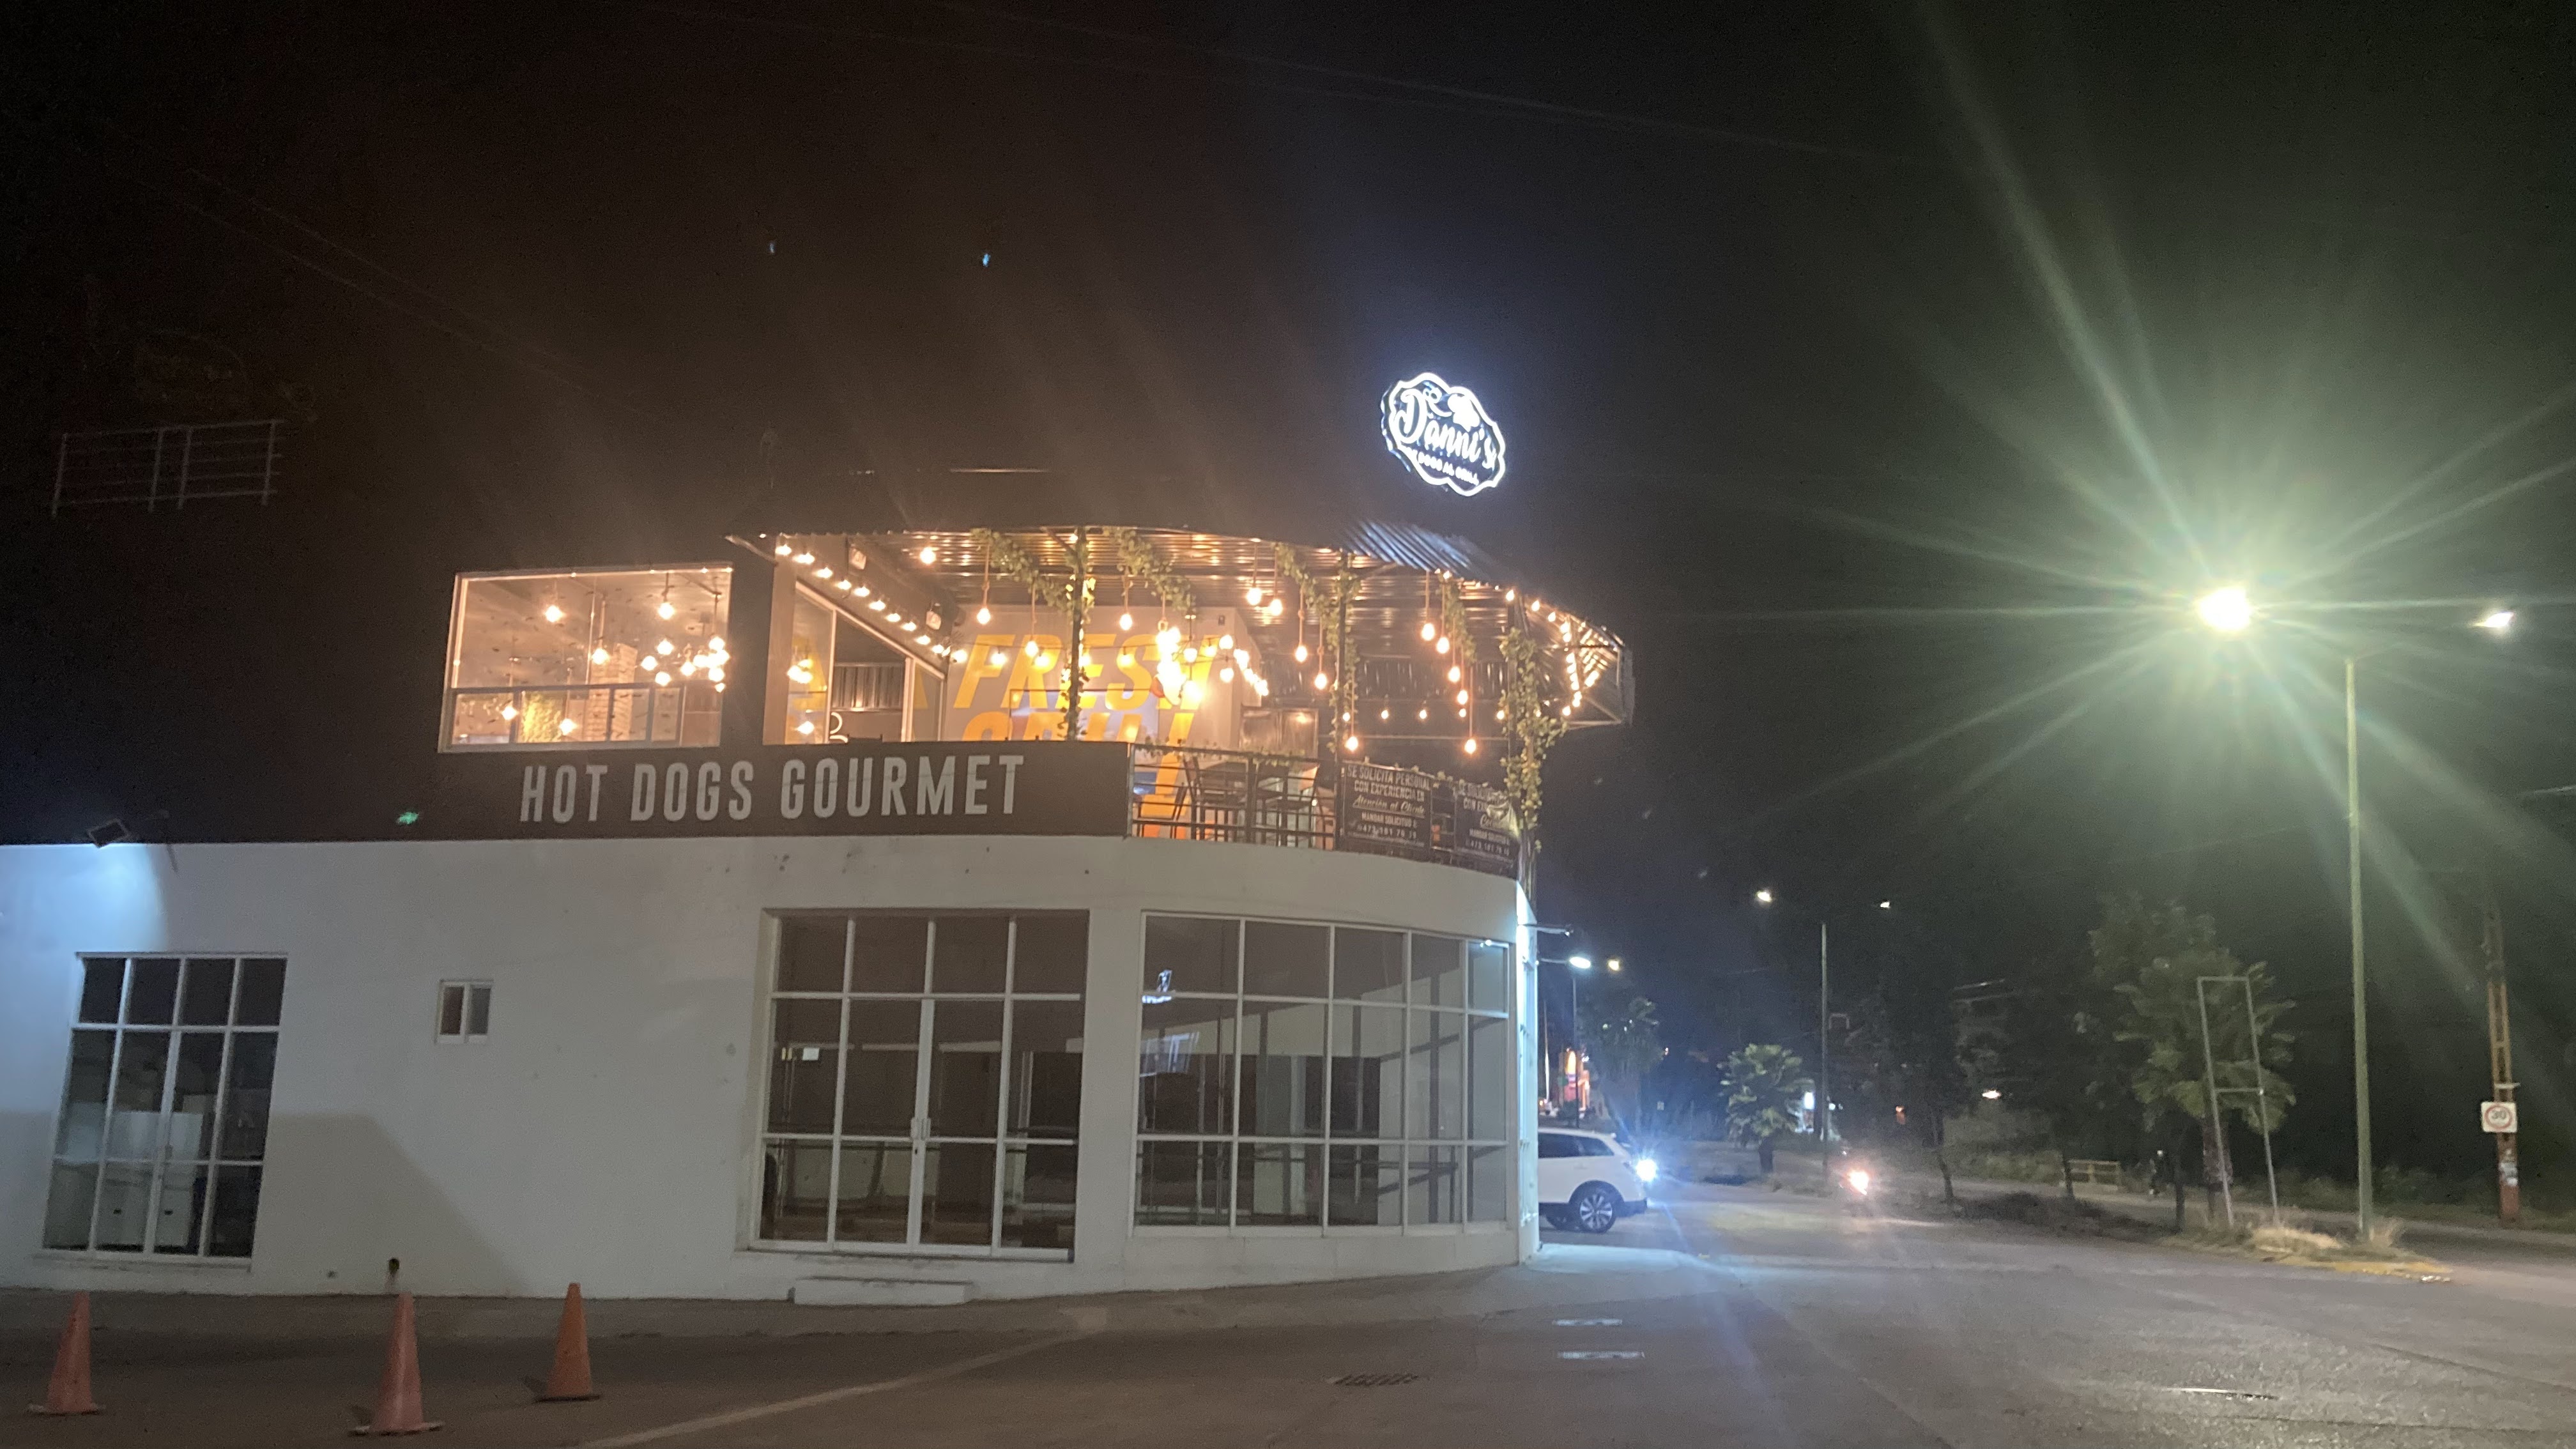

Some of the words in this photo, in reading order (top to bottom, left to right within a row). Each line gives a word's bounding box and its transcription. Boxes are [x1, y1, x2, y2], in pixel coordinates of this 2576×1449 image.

[519, 764, 608, 823] HOT
[630, 760, 754, 822] DOGS
[779, 755, 1024, 820] GOURMET
[1347, 764, 1358, 778] SE
[1359, 765, 1393, 784] SOLICITA
[1395, 772, 1430, 791] PERSONAL
[1354, 779, 1368, 792] CON
[1370, 782, 1416, 800] EXPERIENCIA
